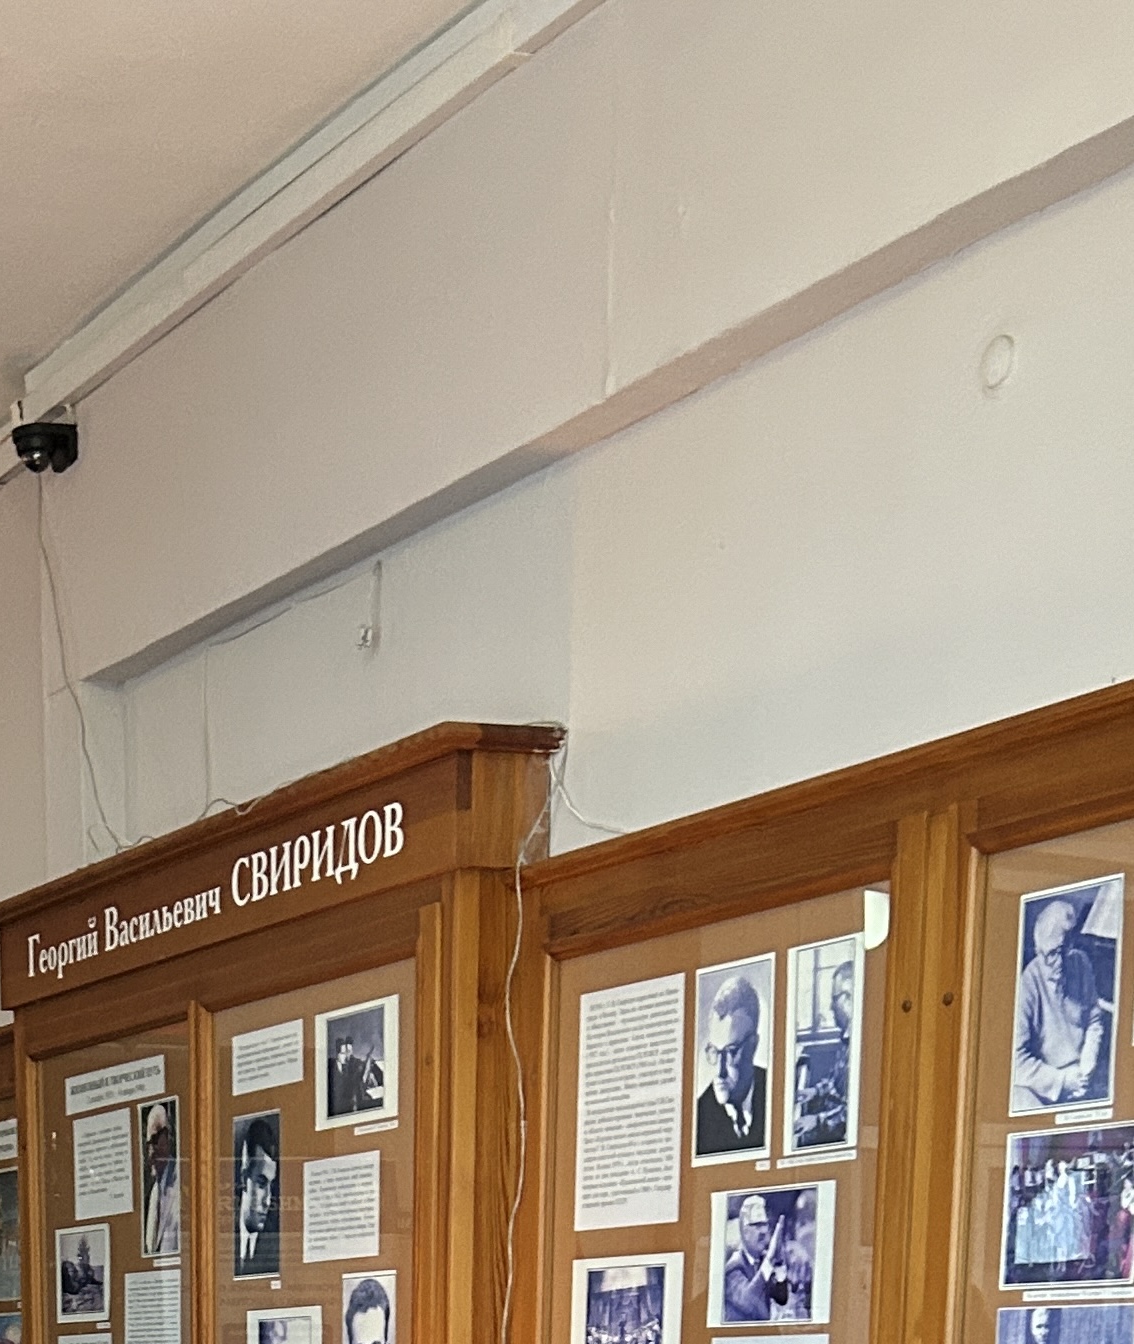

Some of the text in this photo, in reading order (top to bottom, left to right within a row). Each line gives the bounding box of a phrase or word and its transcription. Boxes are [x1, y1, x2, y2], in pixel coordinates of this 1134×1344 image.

[27, 801, 405, 979] Георгий Васильевич СВИРИДОВ
